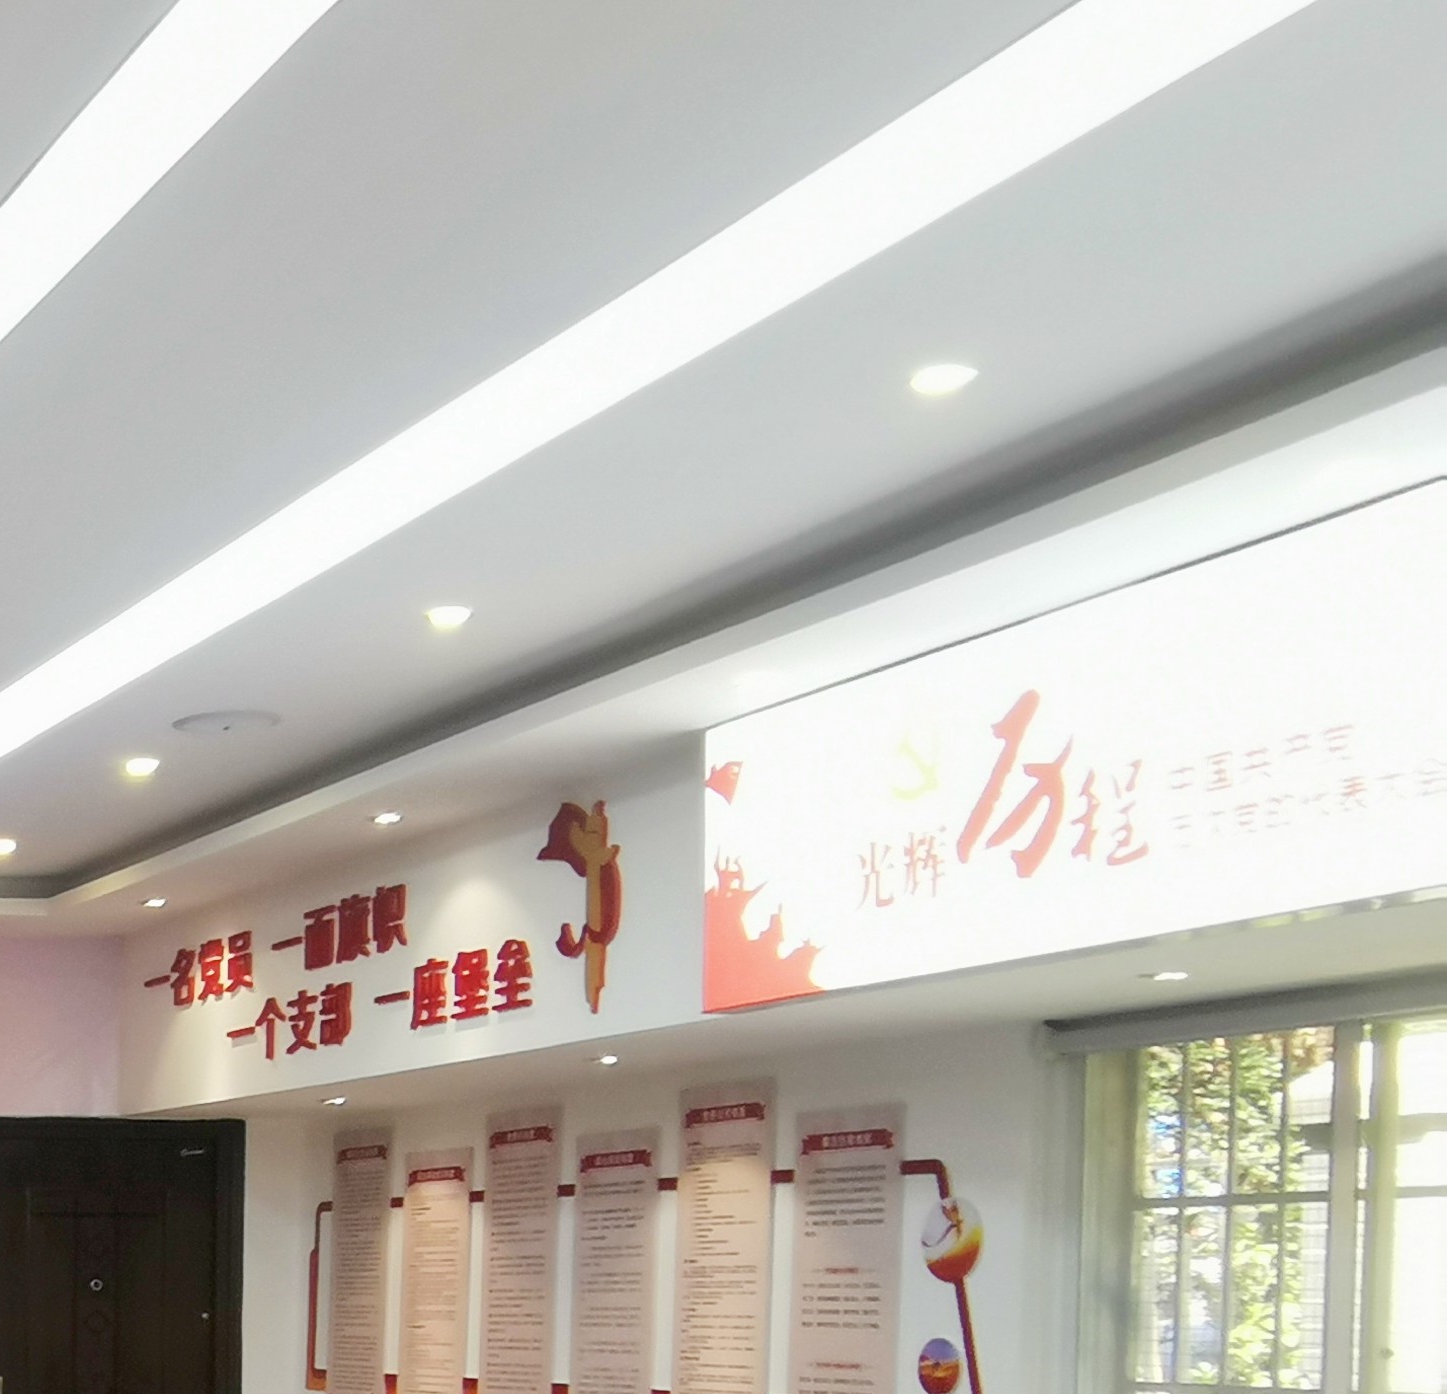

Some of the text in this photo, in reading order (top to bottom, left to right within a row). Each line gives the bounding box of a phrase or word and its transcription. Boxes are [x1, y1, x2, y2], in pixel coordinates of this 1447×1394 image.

[226, 939, 534, 1060] 一个支部 一座堡垒
